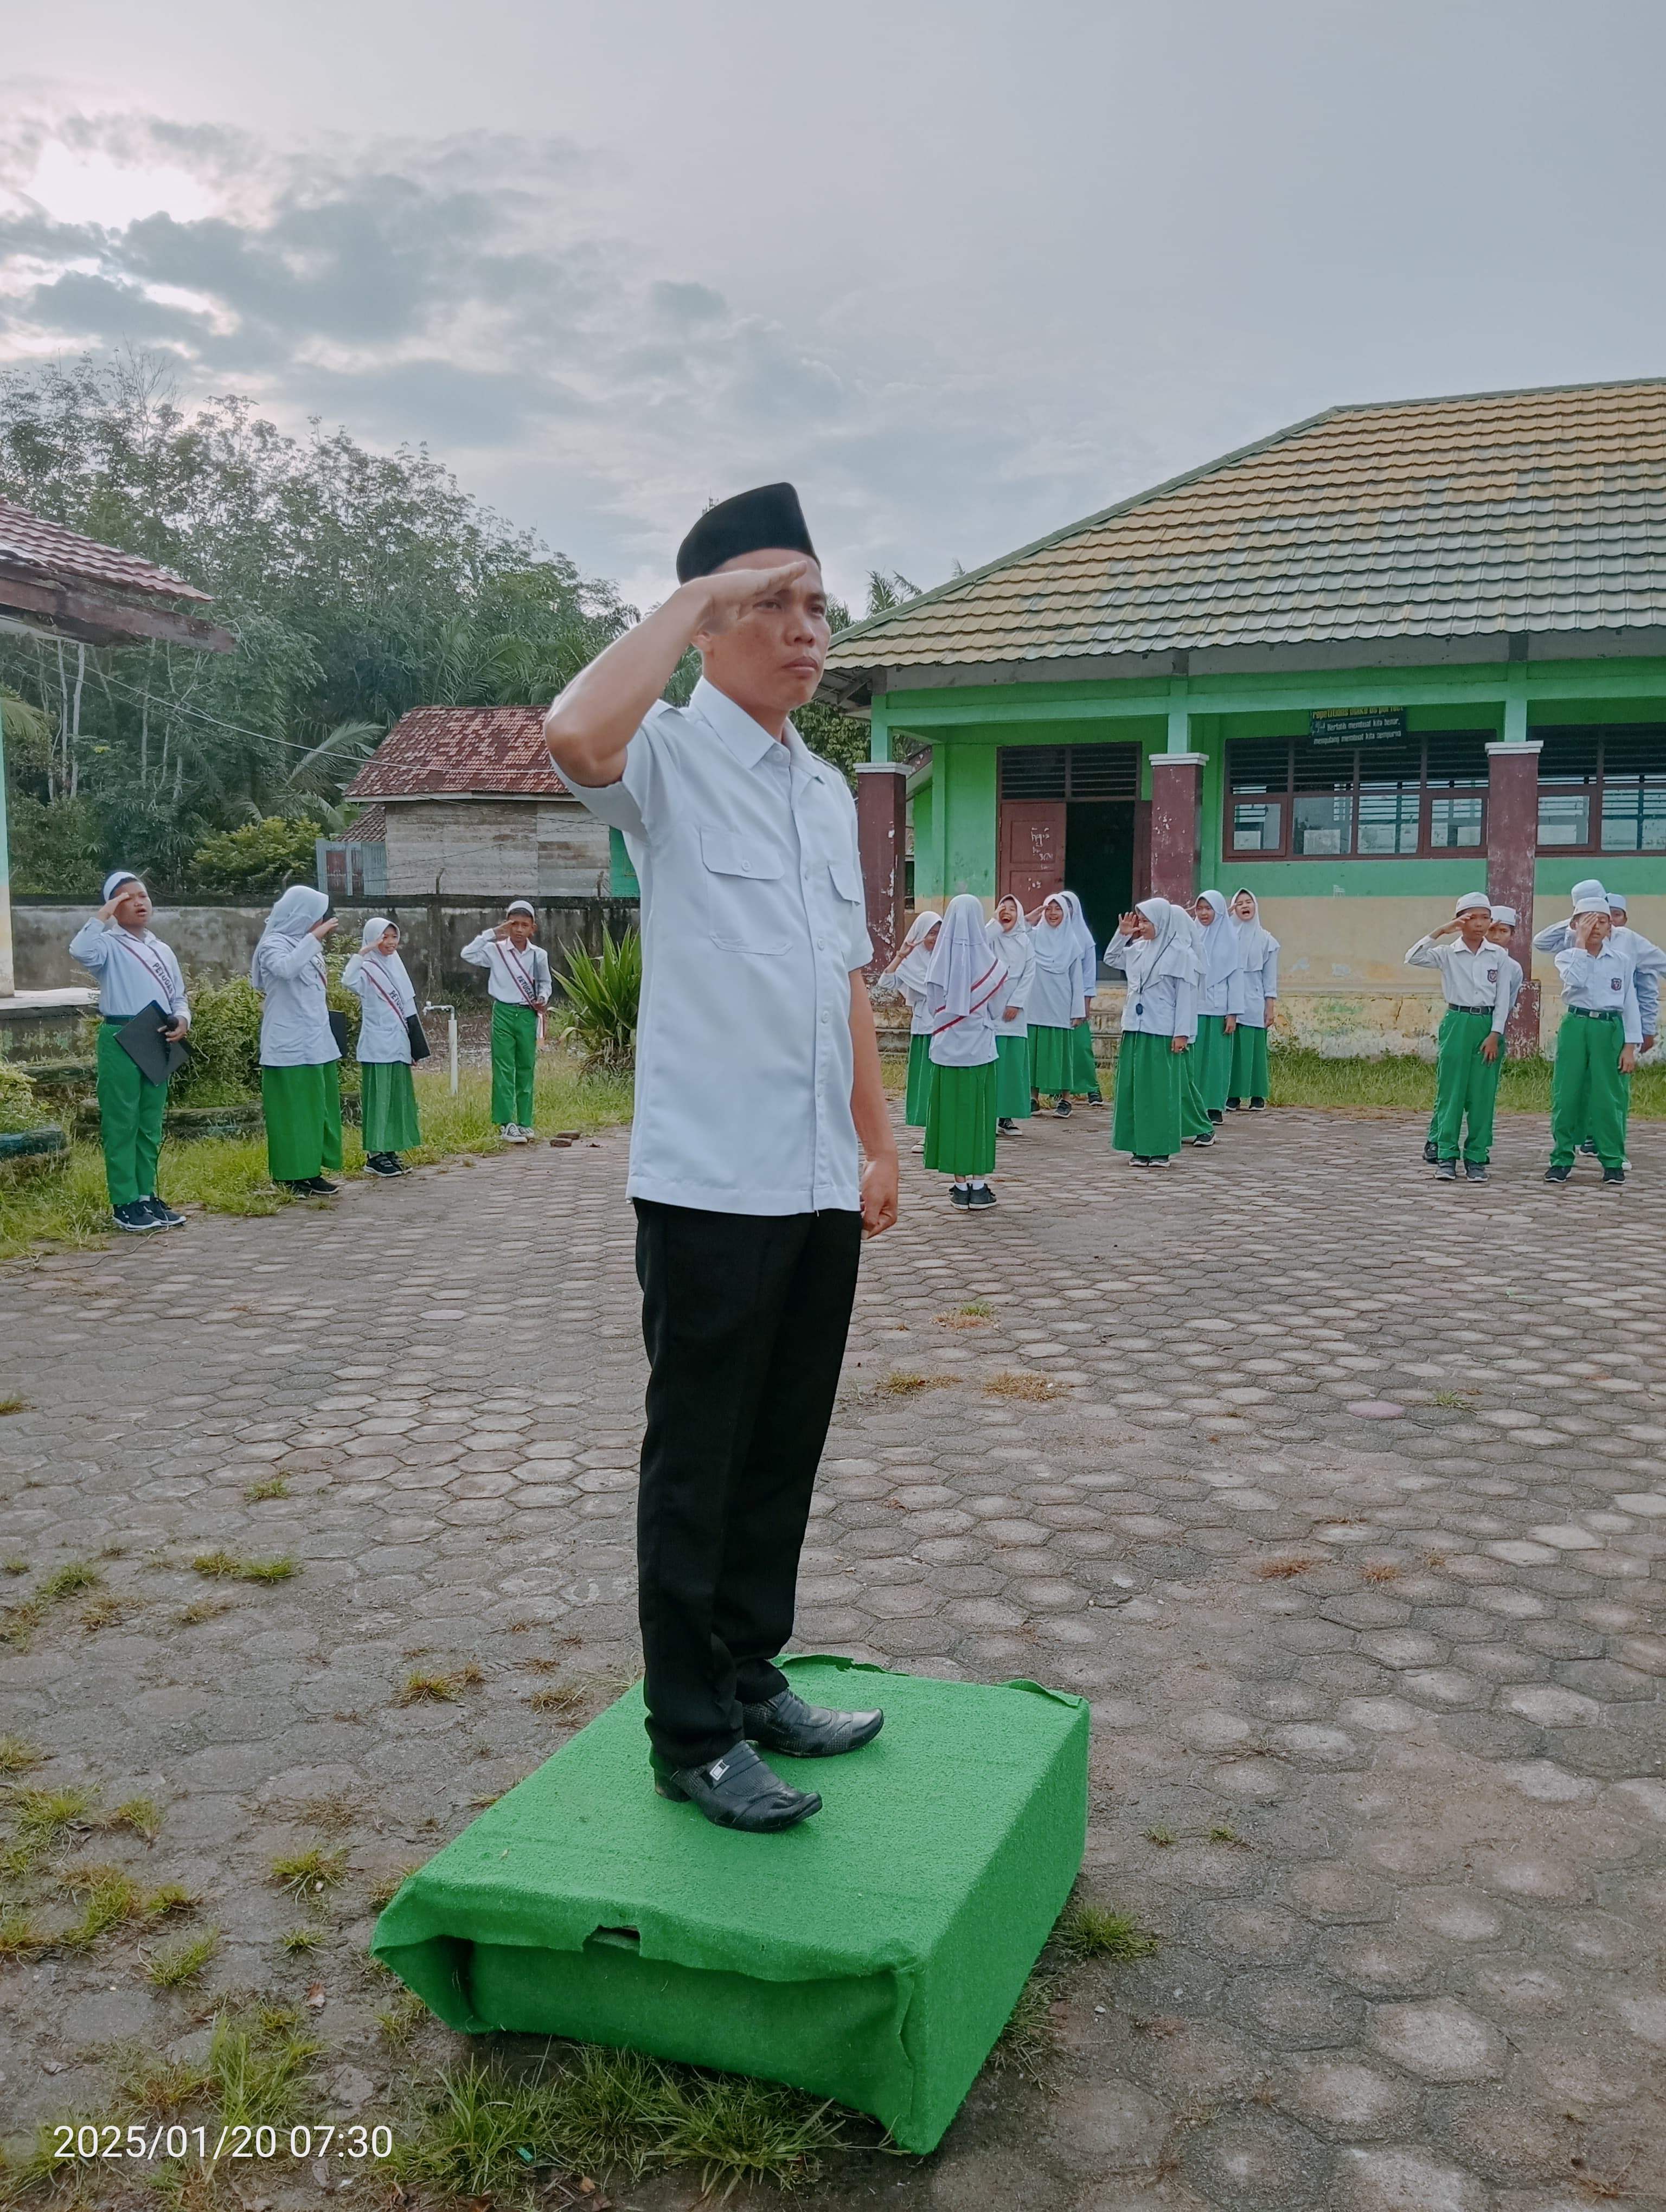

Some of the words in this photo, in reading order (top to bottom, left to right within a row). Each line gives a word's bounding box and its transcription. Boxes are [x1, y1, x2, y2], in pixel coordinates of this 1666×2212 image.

[1348, 721, 1372, 729] membuat
[1341, 734, 1363, 742] membuat
[1376, 731, 1401, 740] sempurna
[152, 962, 172, 994] PETUGAS
[517, 976, 535, 999] PETUGAS
